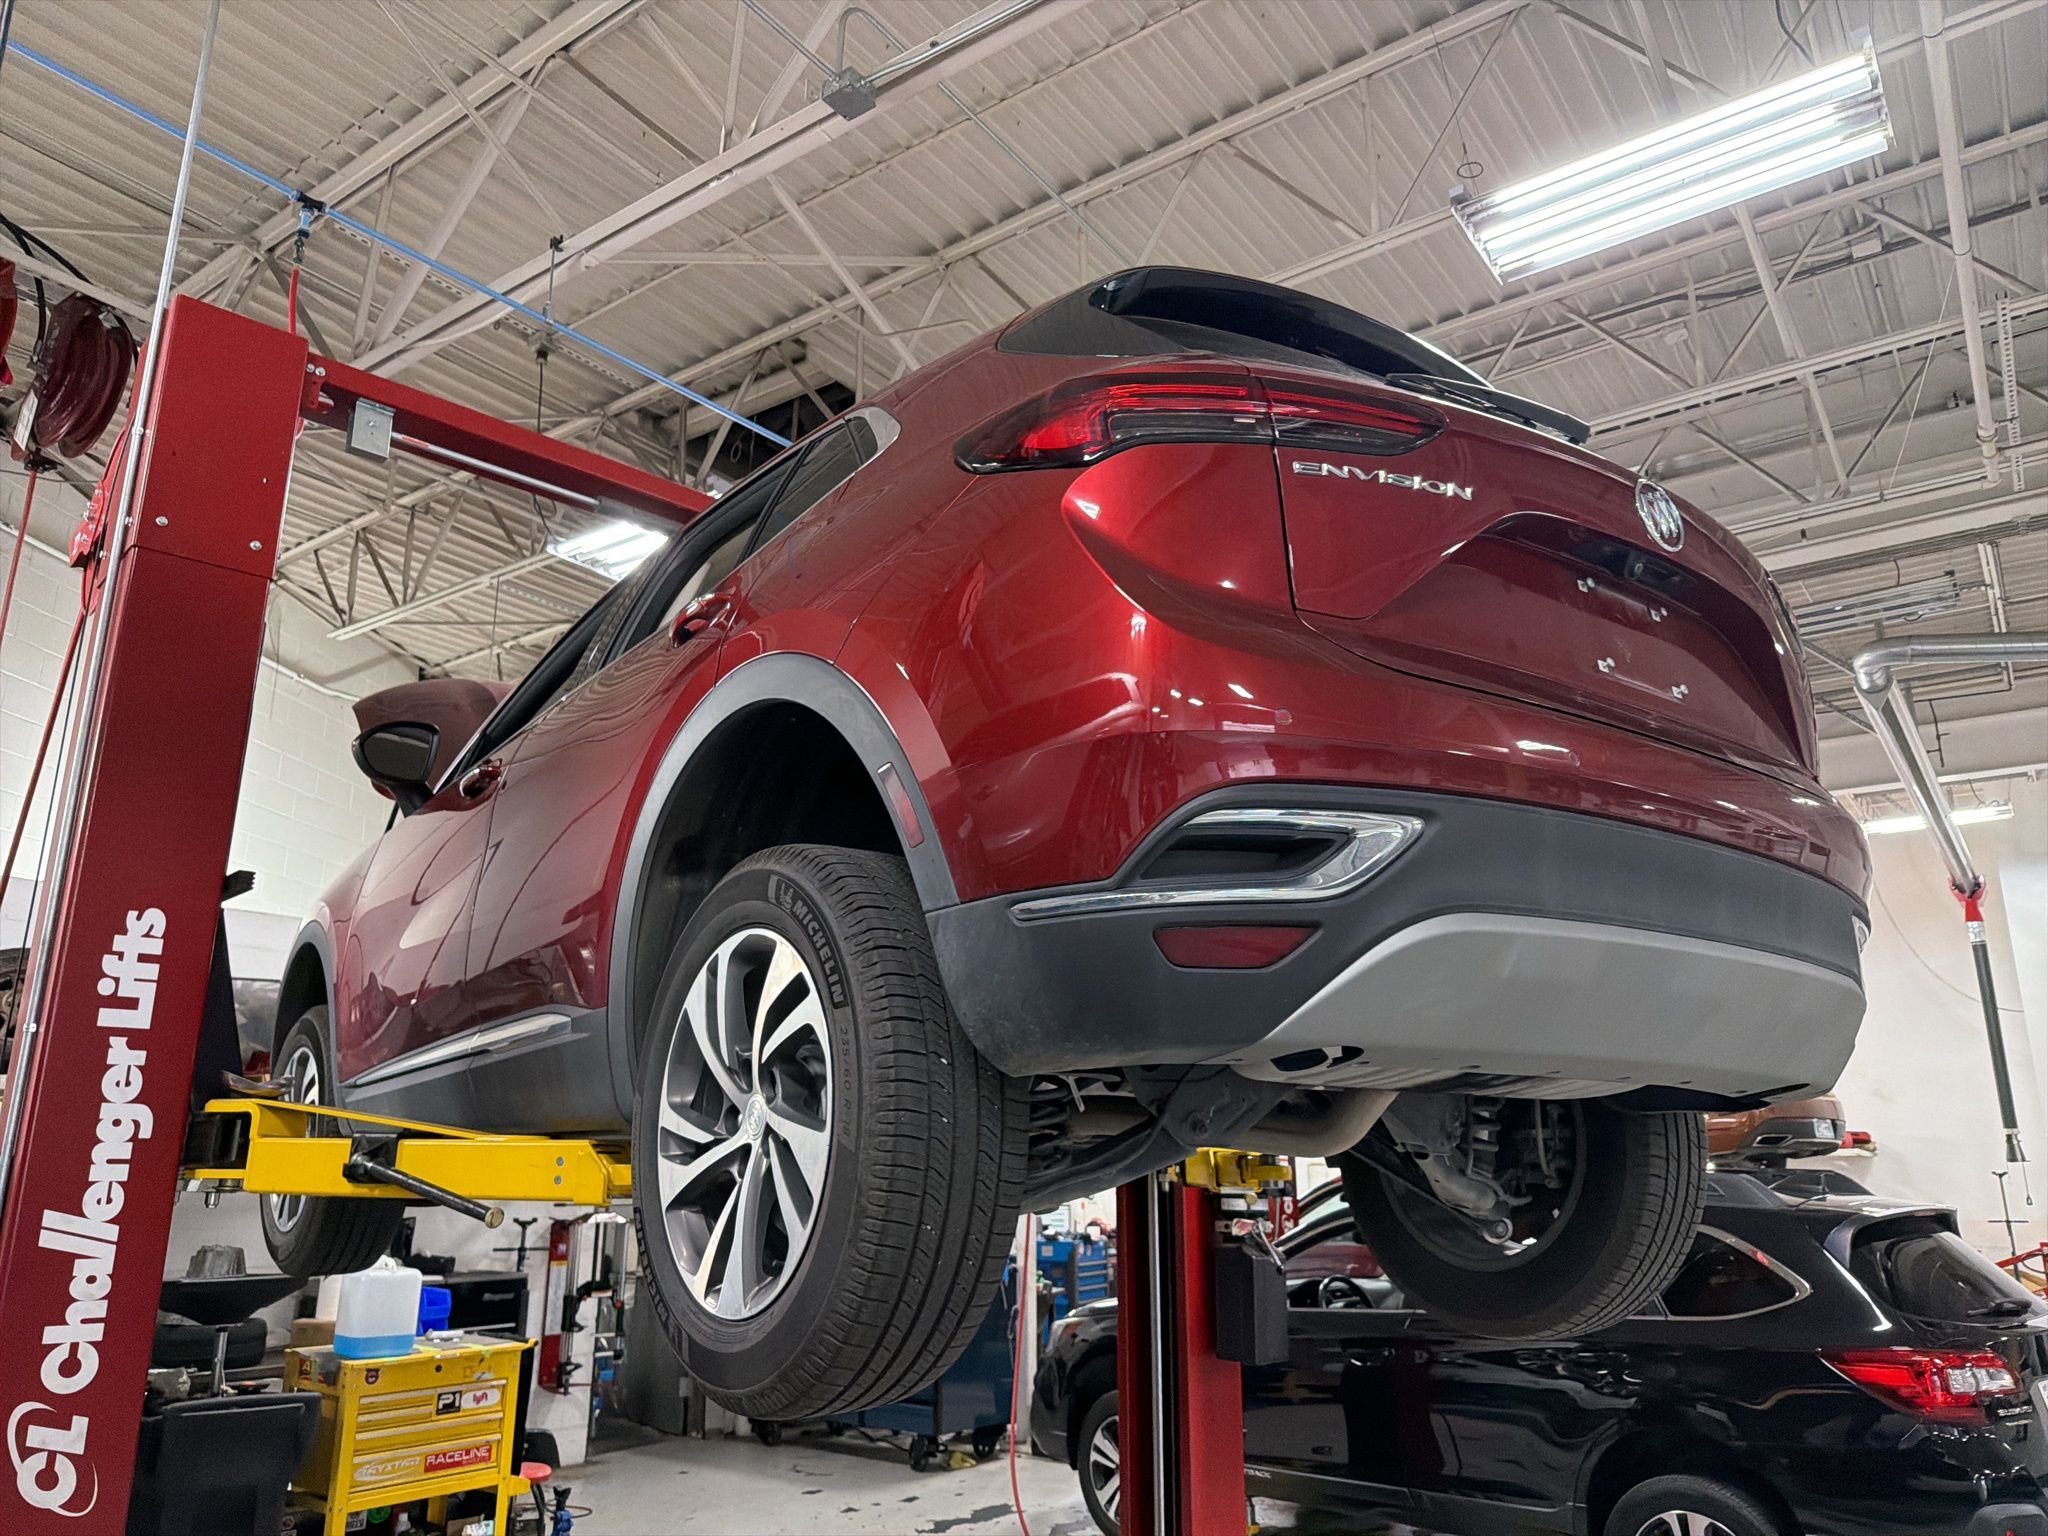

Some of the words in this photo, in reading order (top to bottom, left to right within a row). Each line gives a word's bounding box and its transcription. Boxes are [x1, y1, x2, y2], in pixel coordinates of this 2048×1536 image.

[1292, 461, 1473, 501] ENVISION
[793, 900, 844, 1003] MICHELIN
[38, 1035, 154, 1395] Challenger
[97, 907, 167, 1030] Lifts
[438, 1393, 461, 1410] P1
[426, 1446, 490, 1467] RACELINE
